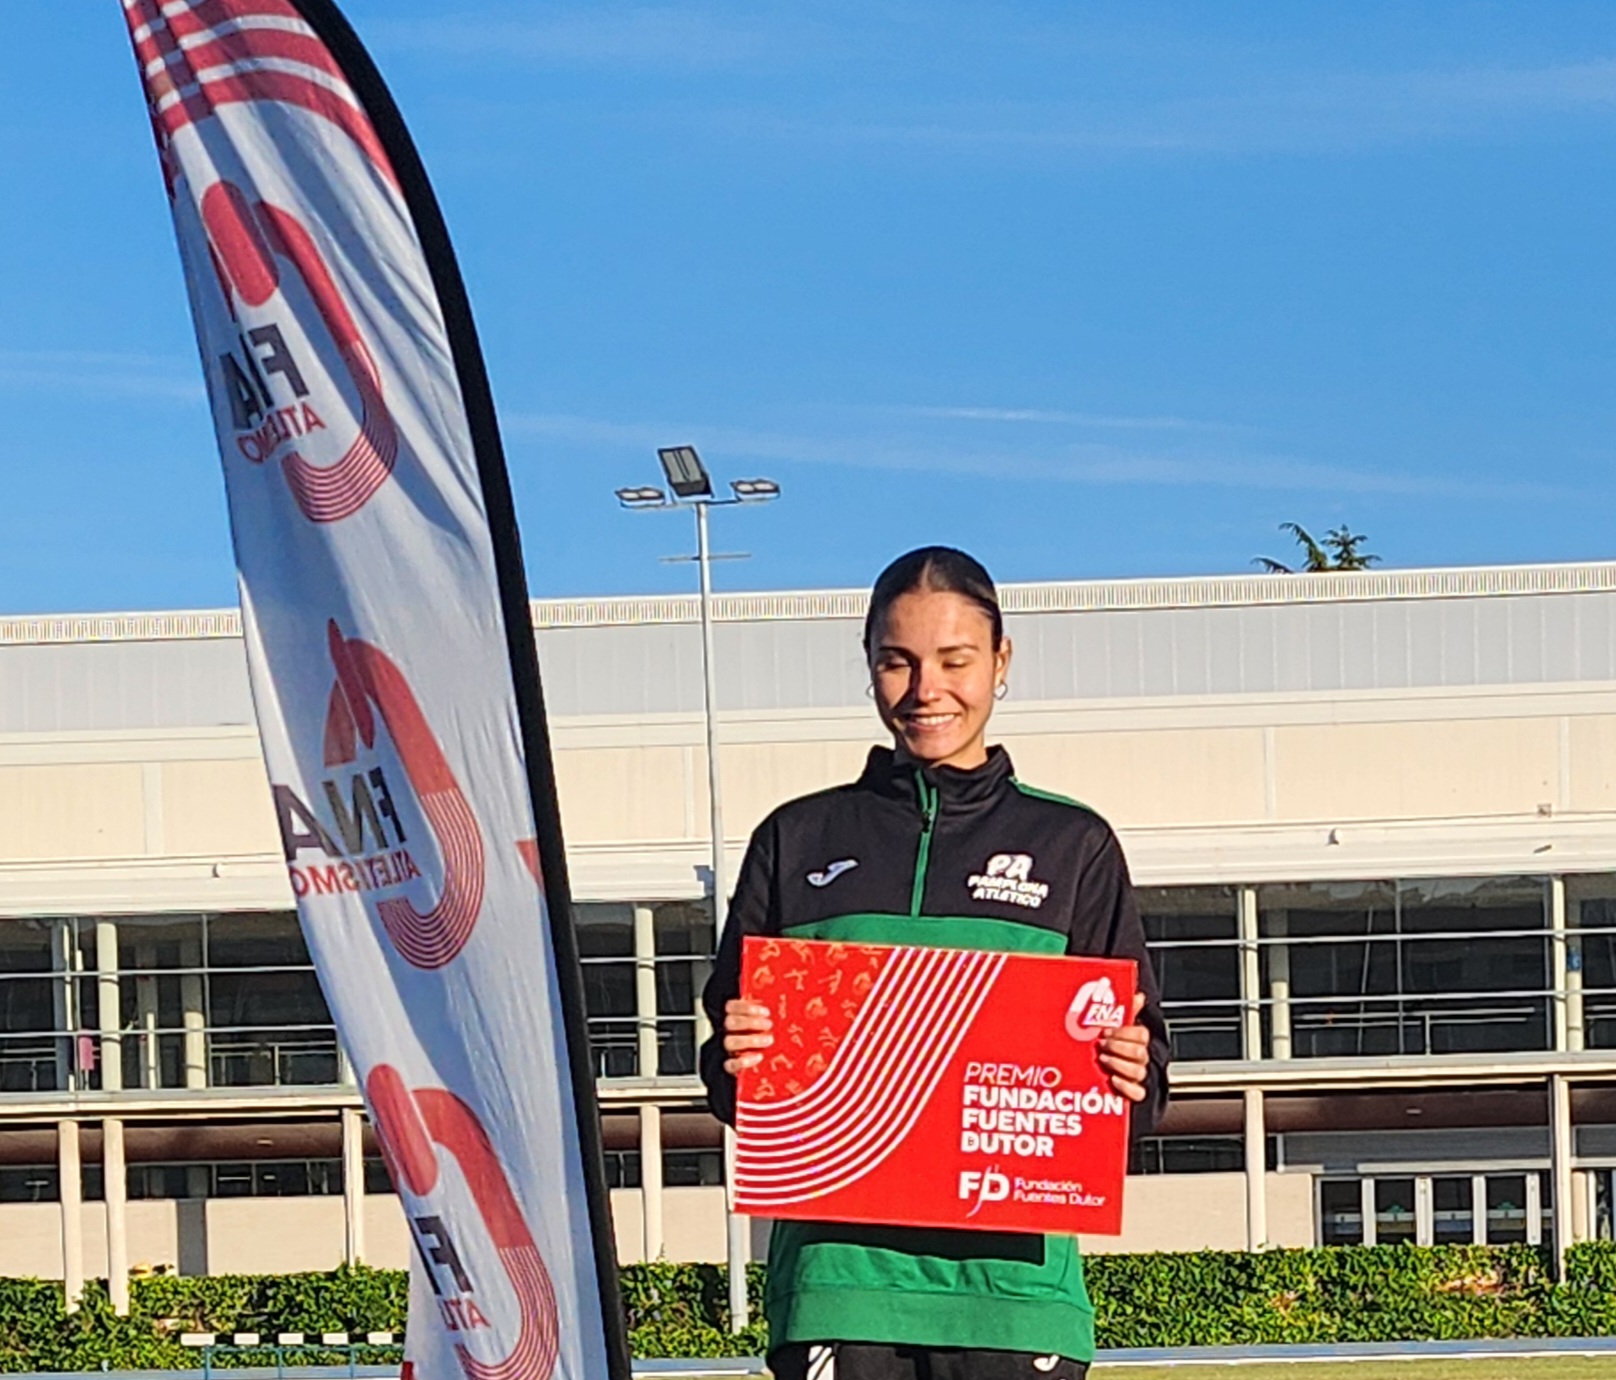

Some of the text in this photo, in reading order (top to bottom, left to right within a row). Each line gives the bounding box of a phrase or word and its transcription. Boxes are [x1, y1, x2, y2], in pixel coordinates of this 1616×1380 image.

[963, 1061, 1062, 1088] PREMIO
[963, 1085, 1123, 1116] FUNDACIÓN
[962, 1108, 1082, 1136] FUENTES
[960, 1131, 1054, 1157] DUTOR
[1014, 1177, 1083, 1193] Fundación
[1013, 1190, 1106, 1207] Fuentes Dutor
